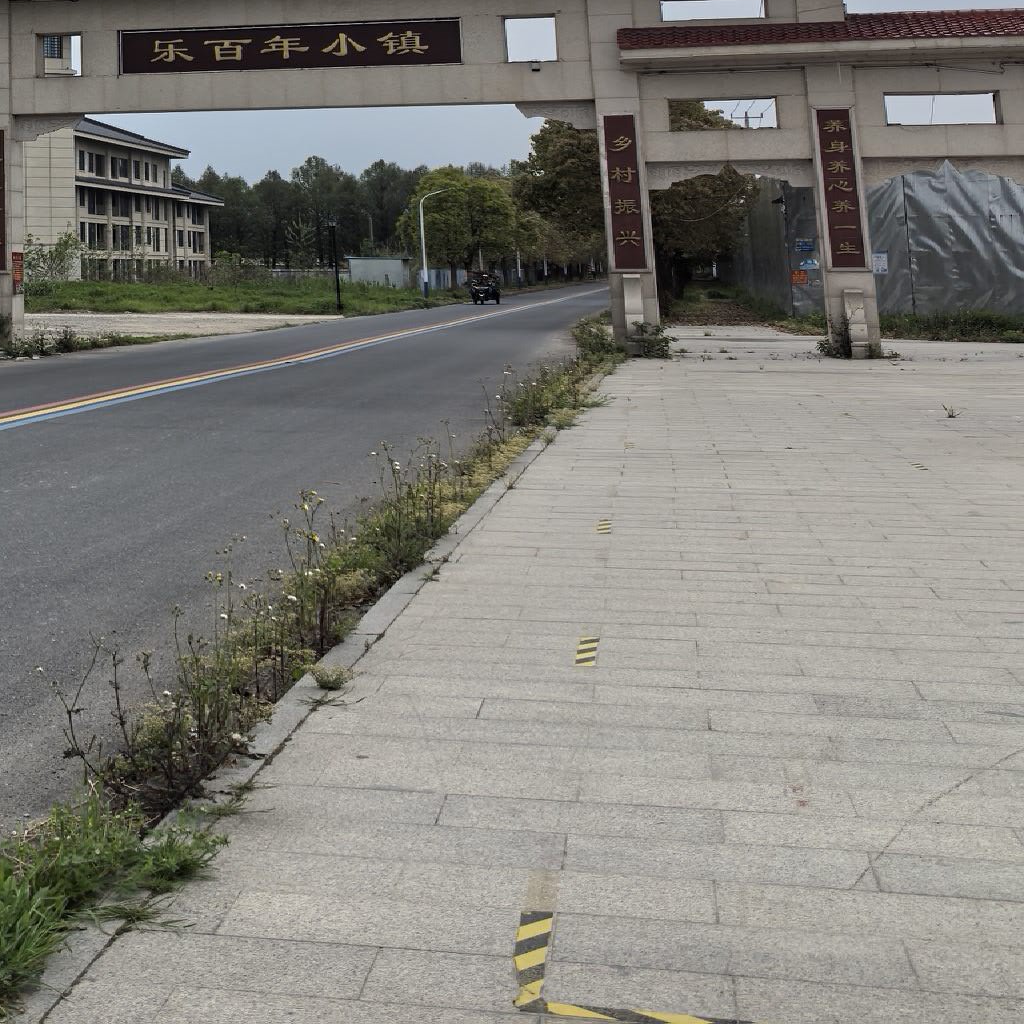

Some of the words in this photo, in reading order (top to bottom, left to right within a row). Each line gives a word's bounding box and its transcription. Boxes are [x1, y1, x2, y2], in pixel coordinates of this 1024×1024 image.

[151, 31, 427, 61] 乐百年小镇
[610, 137, 640, 246] 乡村振兴
[823, 121, 858, 253] 养身养心养一生
